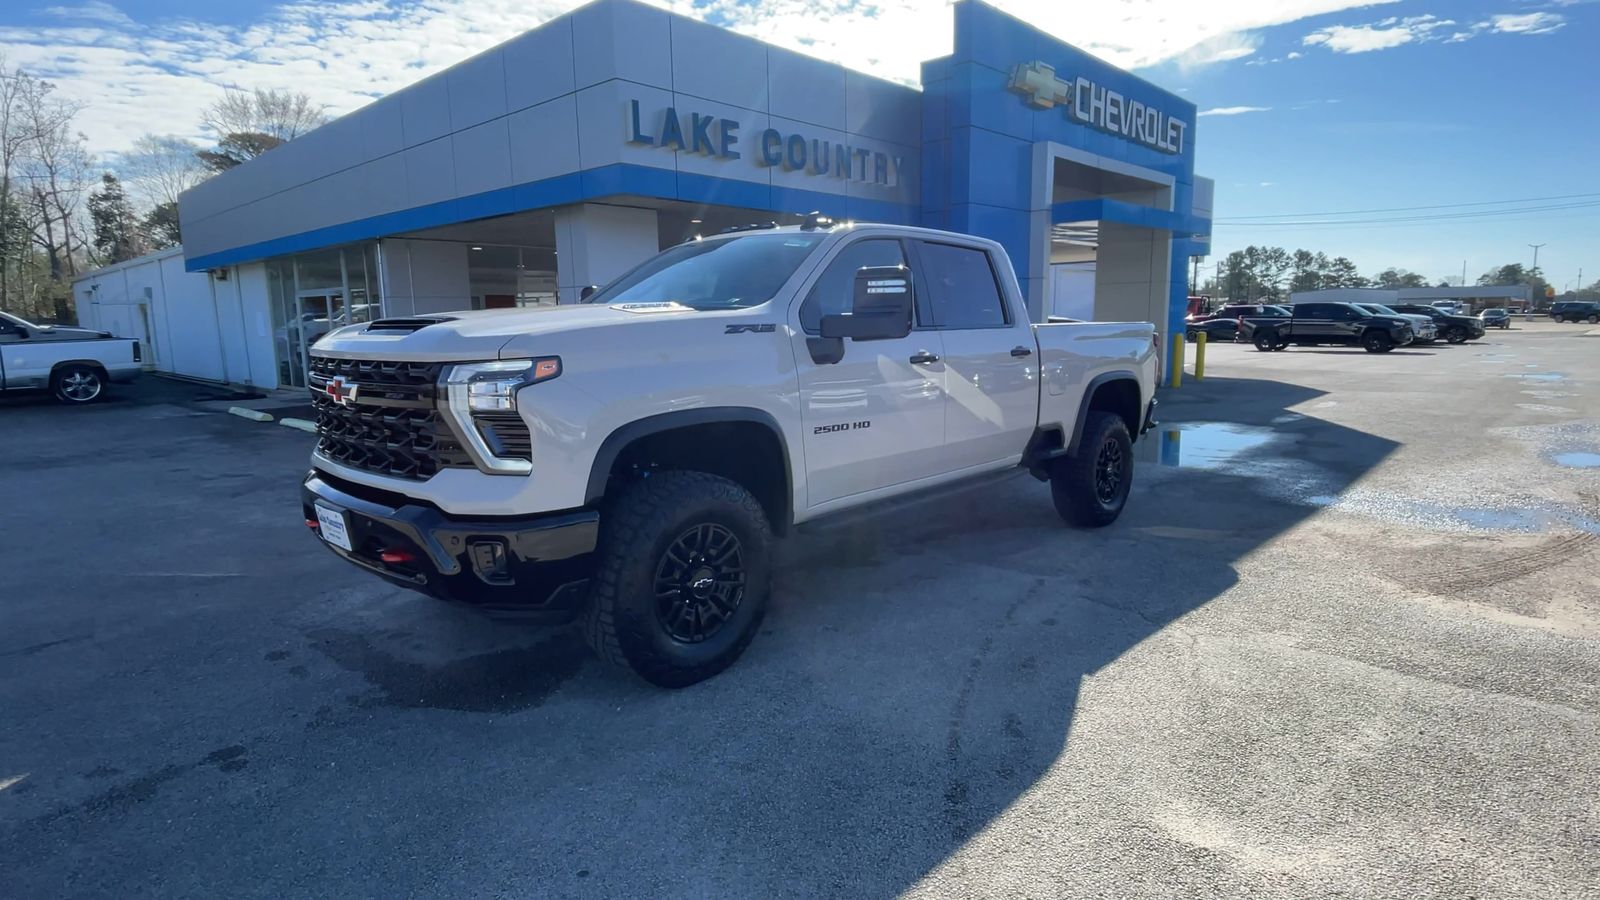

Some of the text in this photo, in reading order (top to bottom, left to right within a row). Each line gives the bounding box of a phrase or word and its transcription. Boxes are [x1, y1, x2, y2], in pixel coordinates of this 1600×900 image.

[627, 99, 905, 185] LAKE COUNTRY
[1075, 76, 1187, 154] CHEVROLET
[813, 420, 871, 435] 2500 HD
